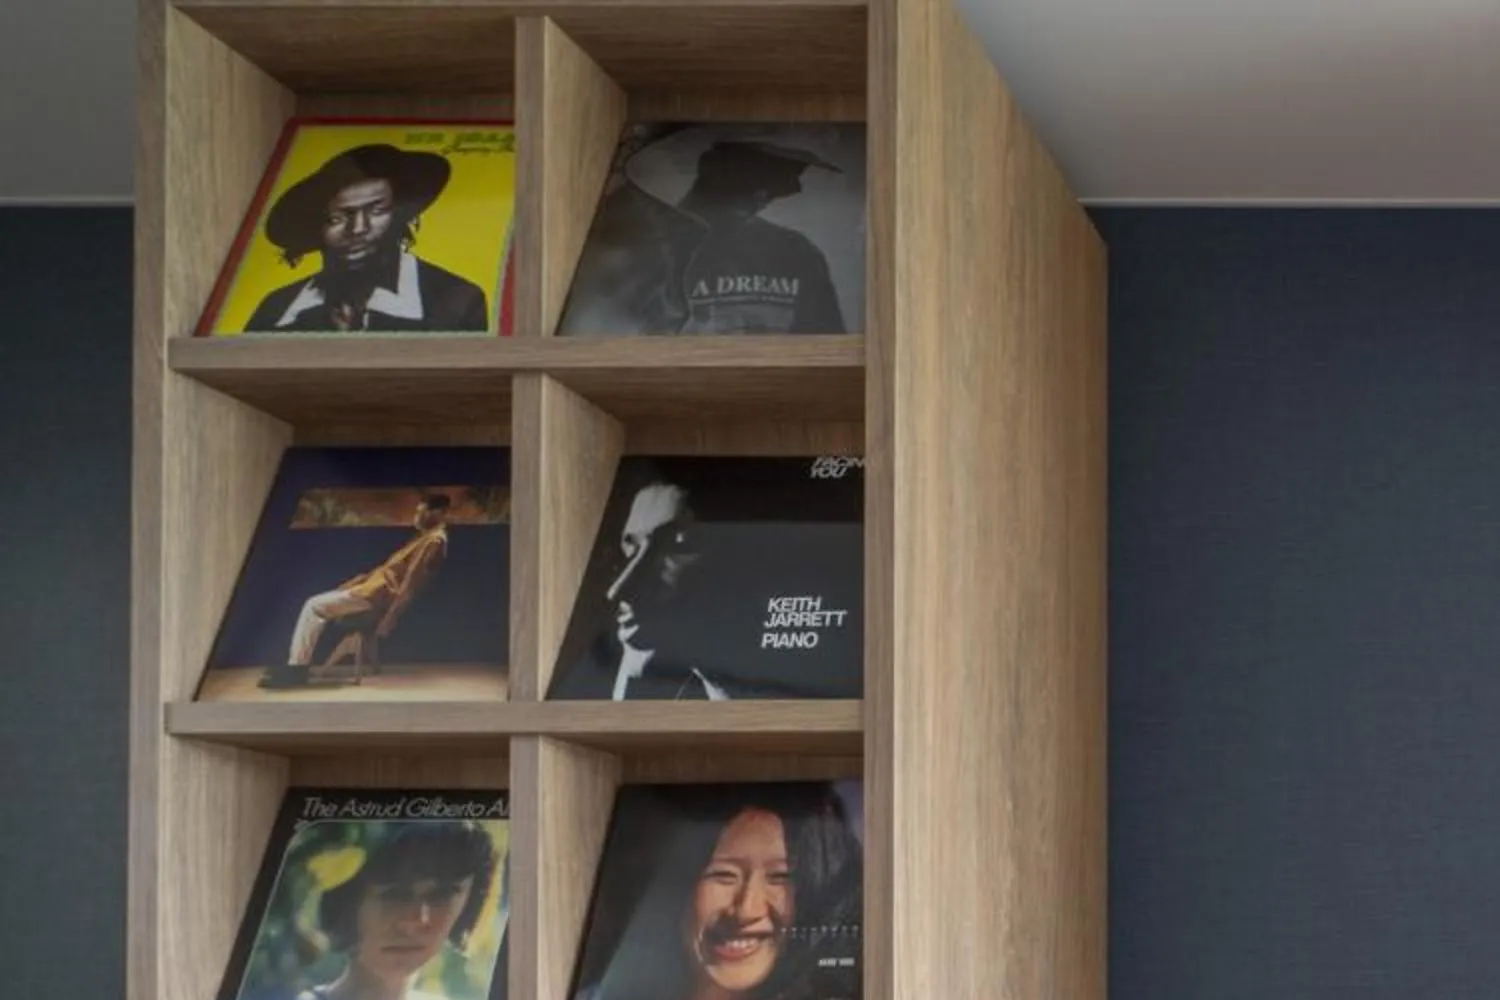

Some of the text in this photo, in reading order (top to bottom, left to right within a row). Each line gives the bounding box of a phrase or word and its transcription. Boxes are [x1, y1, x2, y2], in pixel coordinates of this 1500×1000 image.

[691, 274, 800, 297] A DREAM
[768, 596, 822, 612] KEITH
[763, 609, 848, 628] JARRETT
[761, 631, 819, 648] PIANO
[303, 797, 334, 817] The
[339, 797, 404, 817] Astrud
[405, 796, 484, 817] Gilberto
